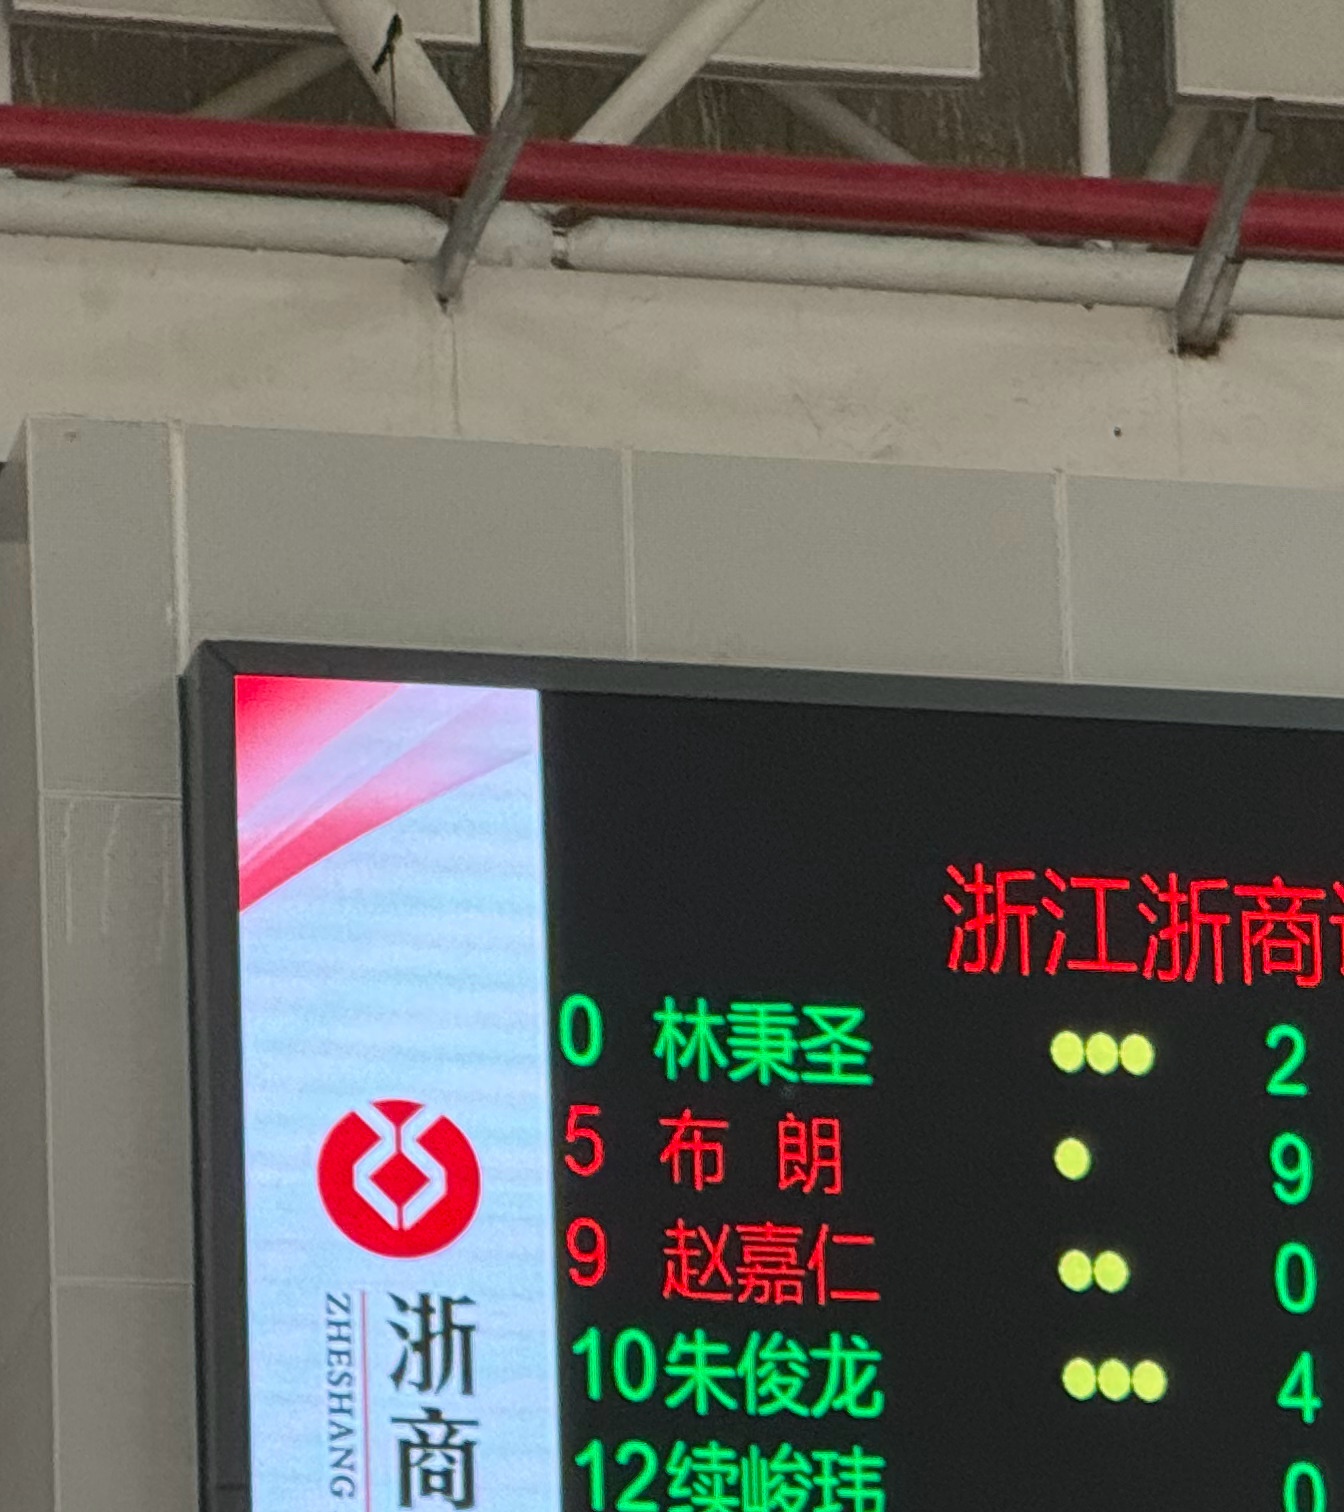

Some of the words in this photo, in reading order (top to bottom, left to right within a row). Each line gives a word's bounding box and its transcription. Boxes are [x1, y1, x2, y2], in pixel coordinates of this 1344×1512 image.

[559, 994, 602, 1066] 0
[654, 996, 872, 1084] 林秉圣
[1266, 1024, 1307, 1095] 2
[564, 1105, 604, 1176] 5
[1270, 1132, 1312, 1204] 9
[566, 1218, 606, 1286] 9
[662, 1218, 880, 1305] 赵嘉仁
[1275, 1242, 1317, 1313] 0
[326, 1293, 356, 1498] ZHESHANG
[1278, 1352, 1321, 1423] 4
